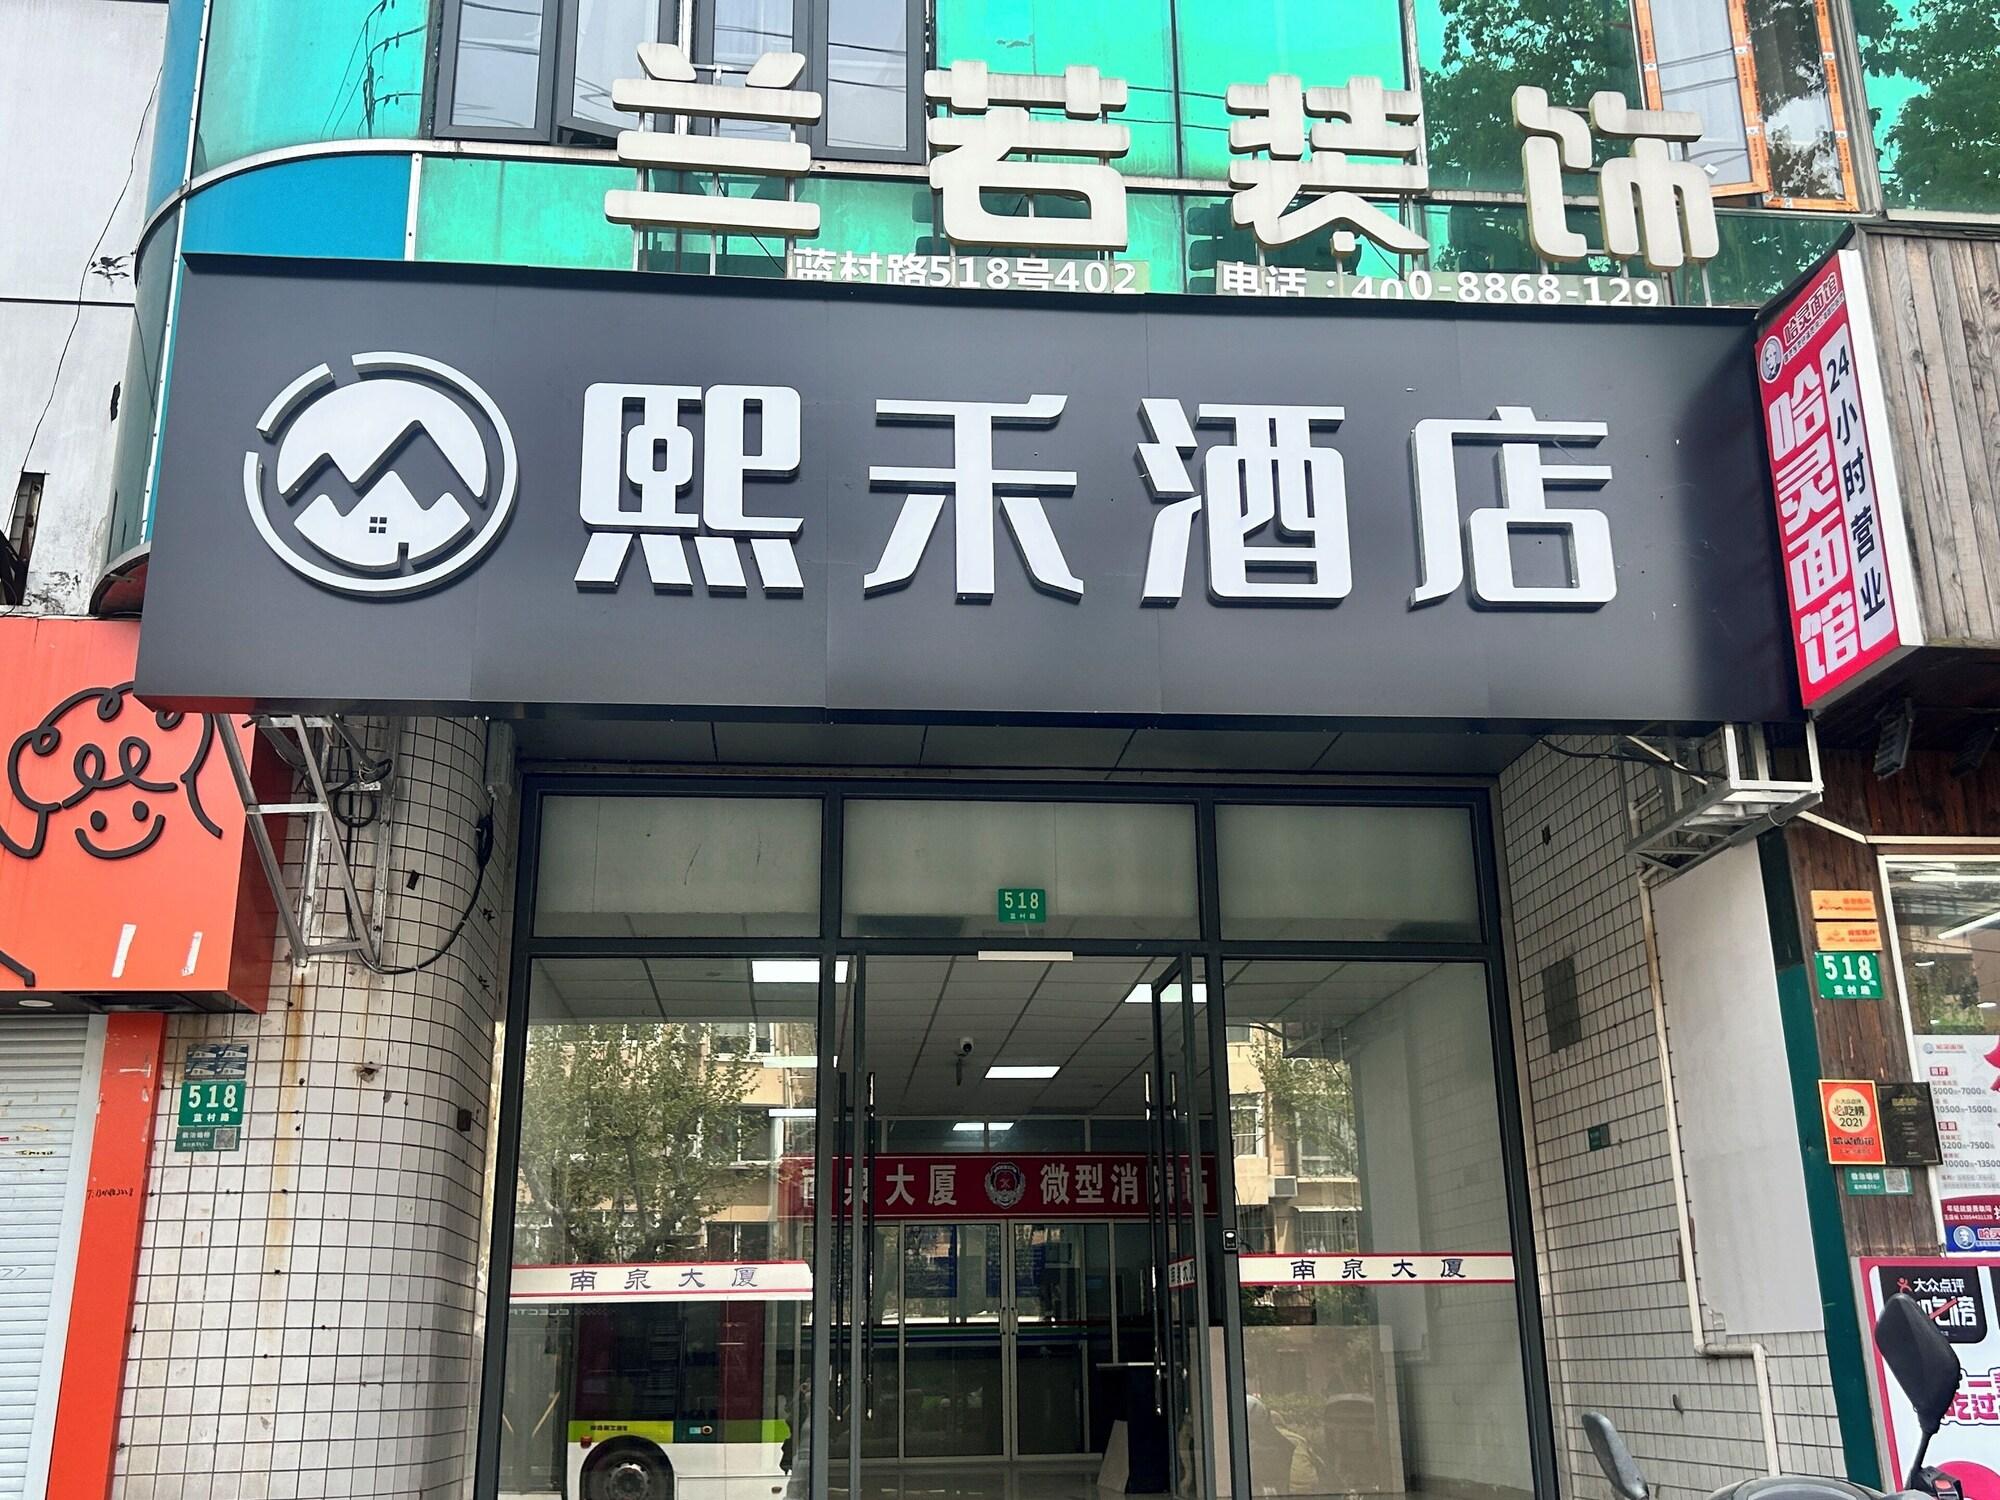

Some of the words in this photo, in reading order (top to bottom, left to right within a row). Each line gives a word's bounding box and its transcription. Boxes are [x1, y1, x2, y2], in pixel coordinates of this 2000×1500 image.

[605, 42, 1719, 271] 兰若装饰
[794, 249, 1136, 293] 蓝村路518号402
[575, 382, 1619, 610] 熙禾酒店
[1826, 345, 1885, 622] 24小时营业
[1768, 363, 1859, 685] 哈灵面馆
[1004, 892, 1039, 909] 518
[1822, 955, 1873, 980] 518
[188, 1085, 237, 1108] 518
[1839, 1118, 1863, 1127] 2021
[569, 1266, 759, 1292] 南泉大厦
[1291, 1258, 1467, 1280] 南泉大厦
[1913, 1278, 1965, 1293] 大众点评
[1916, 1296, 1978, 1327] 吃榜
